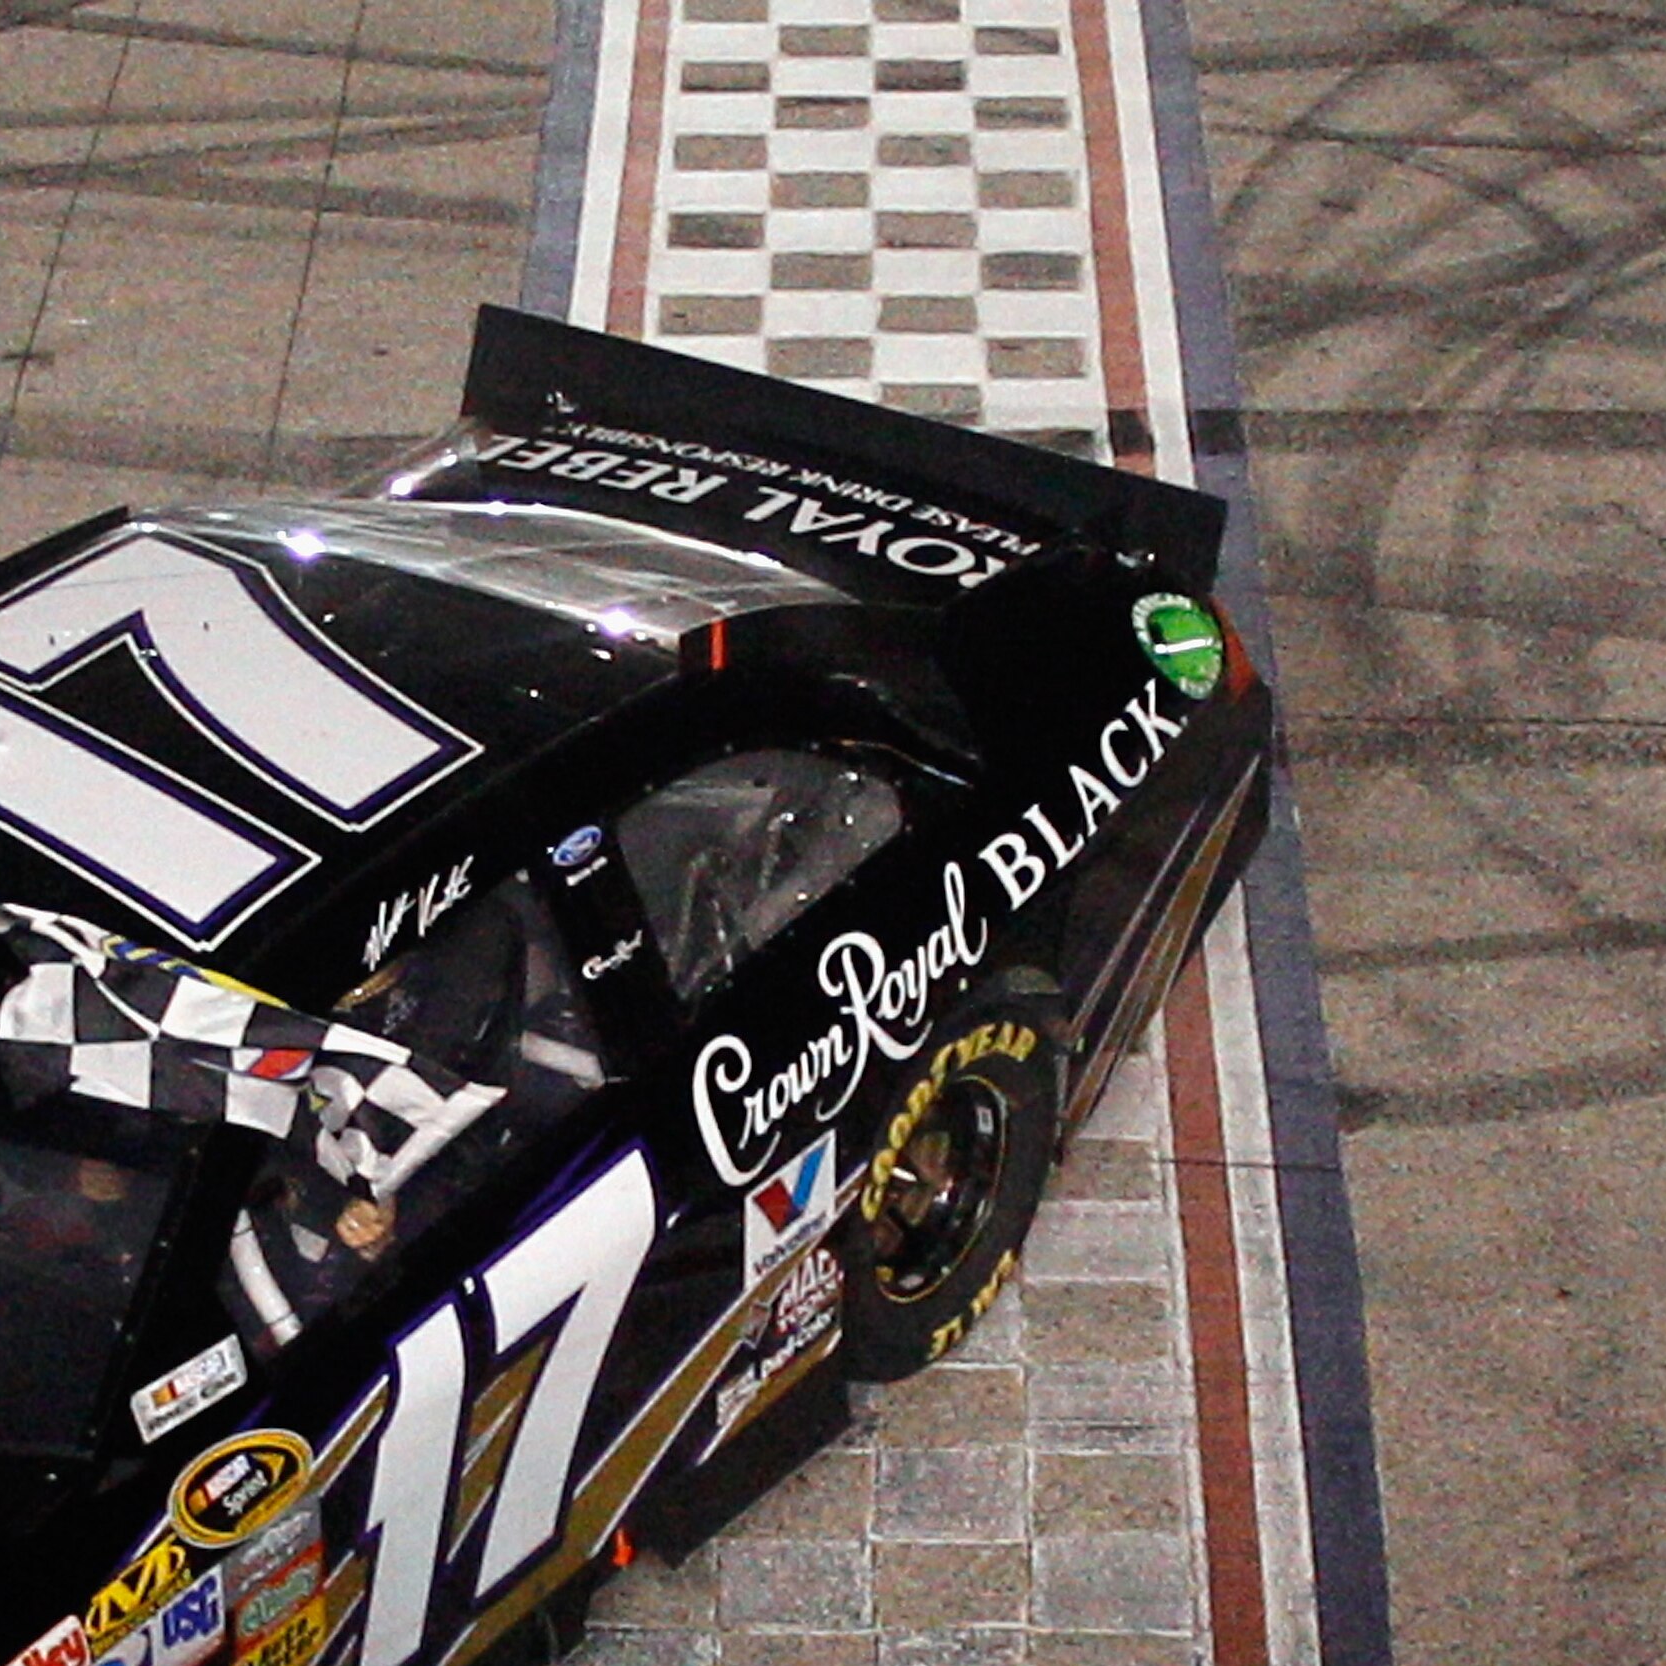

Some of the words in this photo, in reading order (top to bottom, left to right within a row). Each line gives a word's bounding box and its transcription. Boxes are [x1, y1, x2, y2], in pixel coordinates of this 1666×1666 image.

[476, 433, 726, 505] REBEL
[789, 466, 909, 520] DRINK
[692, 1034, 855, 1187] Crown
[816, 862, 986, 1121] Royal
[977, 678, 1183, 911] BLACK
